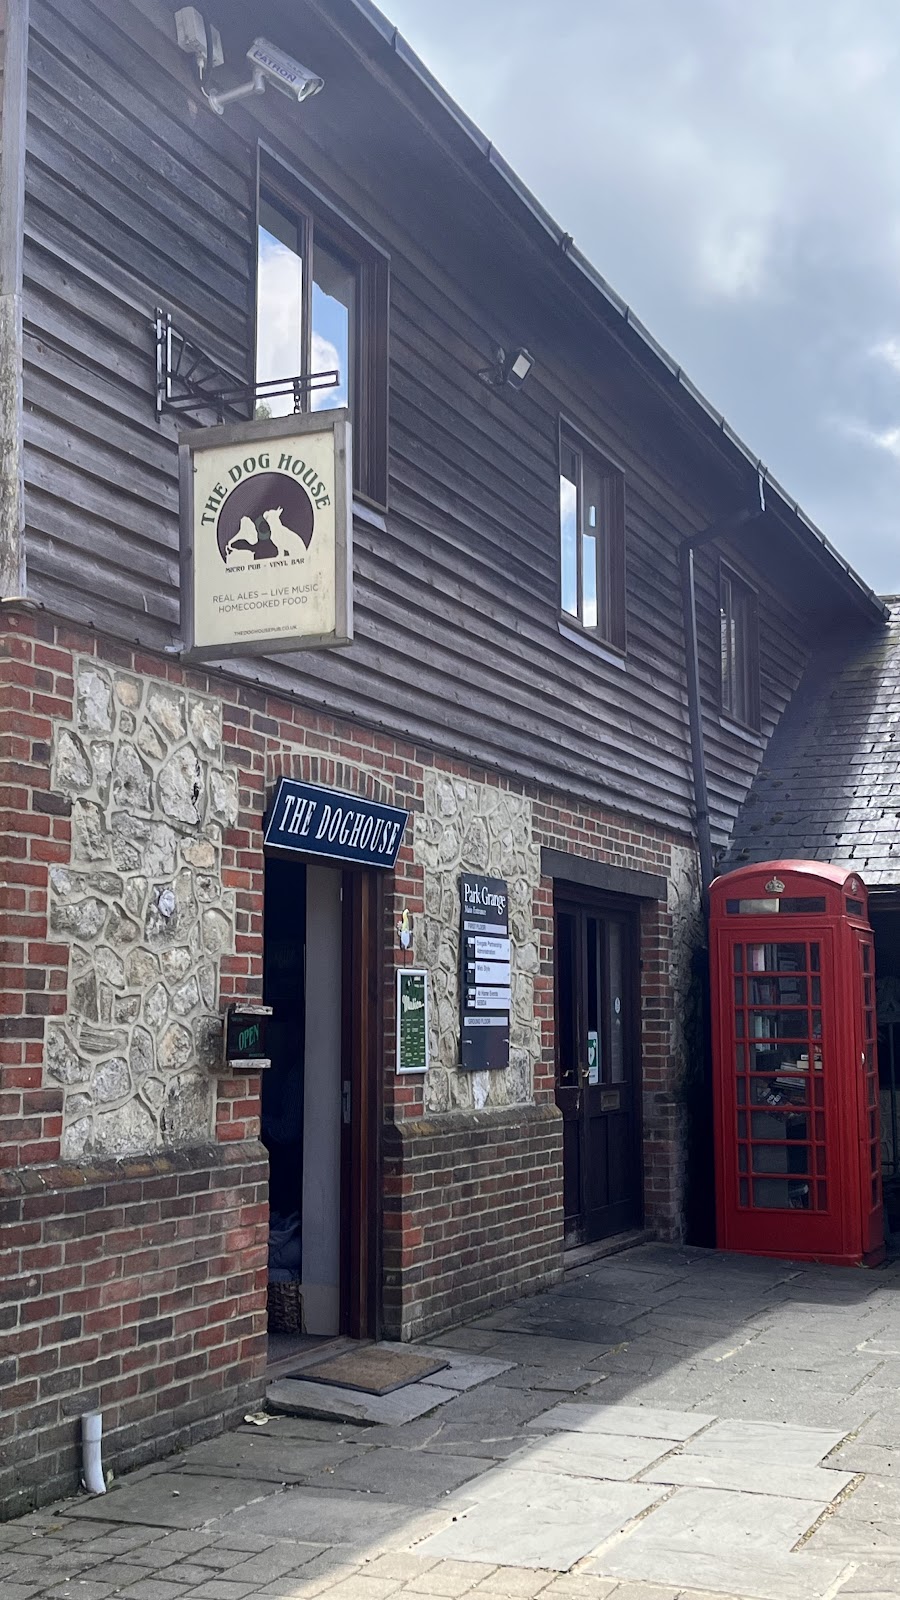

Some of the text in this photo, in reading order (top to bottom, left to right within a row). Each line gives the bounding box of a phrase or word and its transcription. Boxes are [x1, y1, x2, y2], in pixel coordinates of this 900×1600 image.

[254, 50, 297, 83] PATRON
[201, 453, 330, 527] THE DOG HOUSE
[225, 565, 245, 573] MICRO
[248, 563, 261, 571] PUB
[269, 561, 288, 569] VINYL
[213, 594, 235, 604] REAL
[237, 591, 259, 600] ALES
[271, 587, 289, 597] LIVE
[291, 583, 319, 594] MUSIC
[218, 596, 308, 613] HOMECOOKED FOOD
[278, 794, 401, 855] THE DOGHOUSE
[464, 882, 506, 915] Park Grange
[238, 1023, 260, 1051] OPEN
